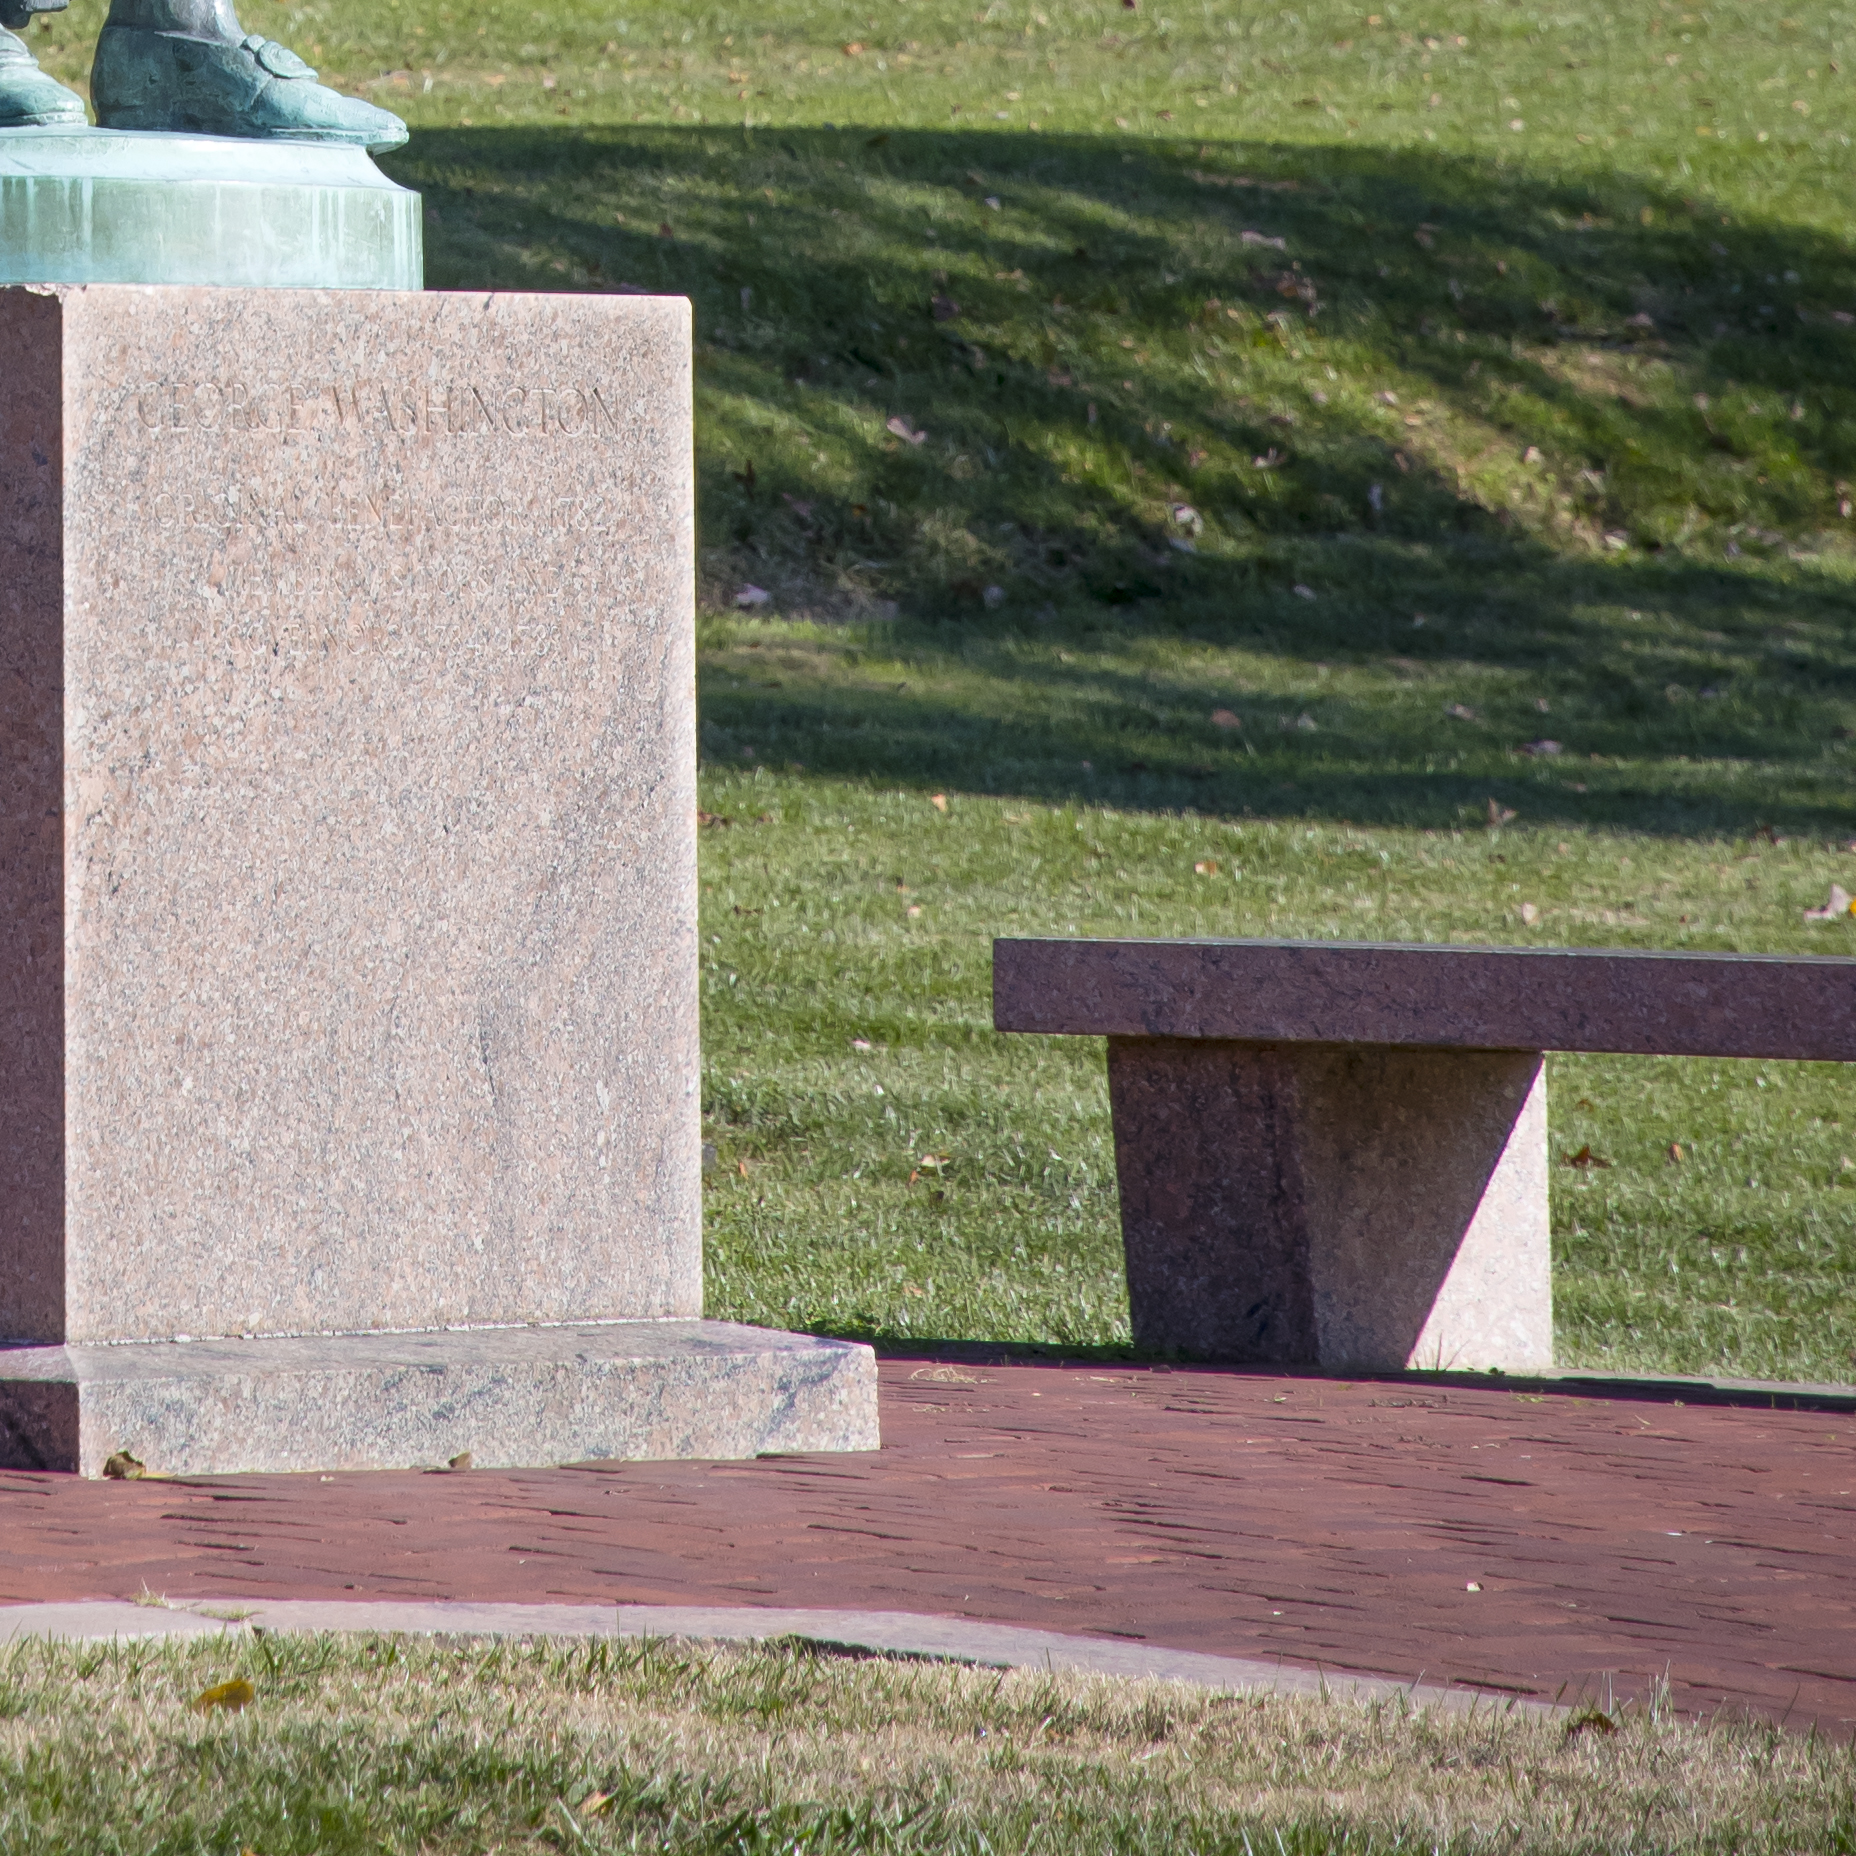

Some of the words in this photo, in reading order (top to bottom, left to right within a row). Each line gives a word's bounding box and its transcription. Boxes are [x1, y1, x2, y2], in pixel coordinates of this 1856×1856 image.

[137, 381, 308, 433] GEORGE
[329, 383, 621, 439] WASHINGTON
[153, 492, 305, 529] ORIGINAL
[329, 494, 530, 530] BENEFACTOR
